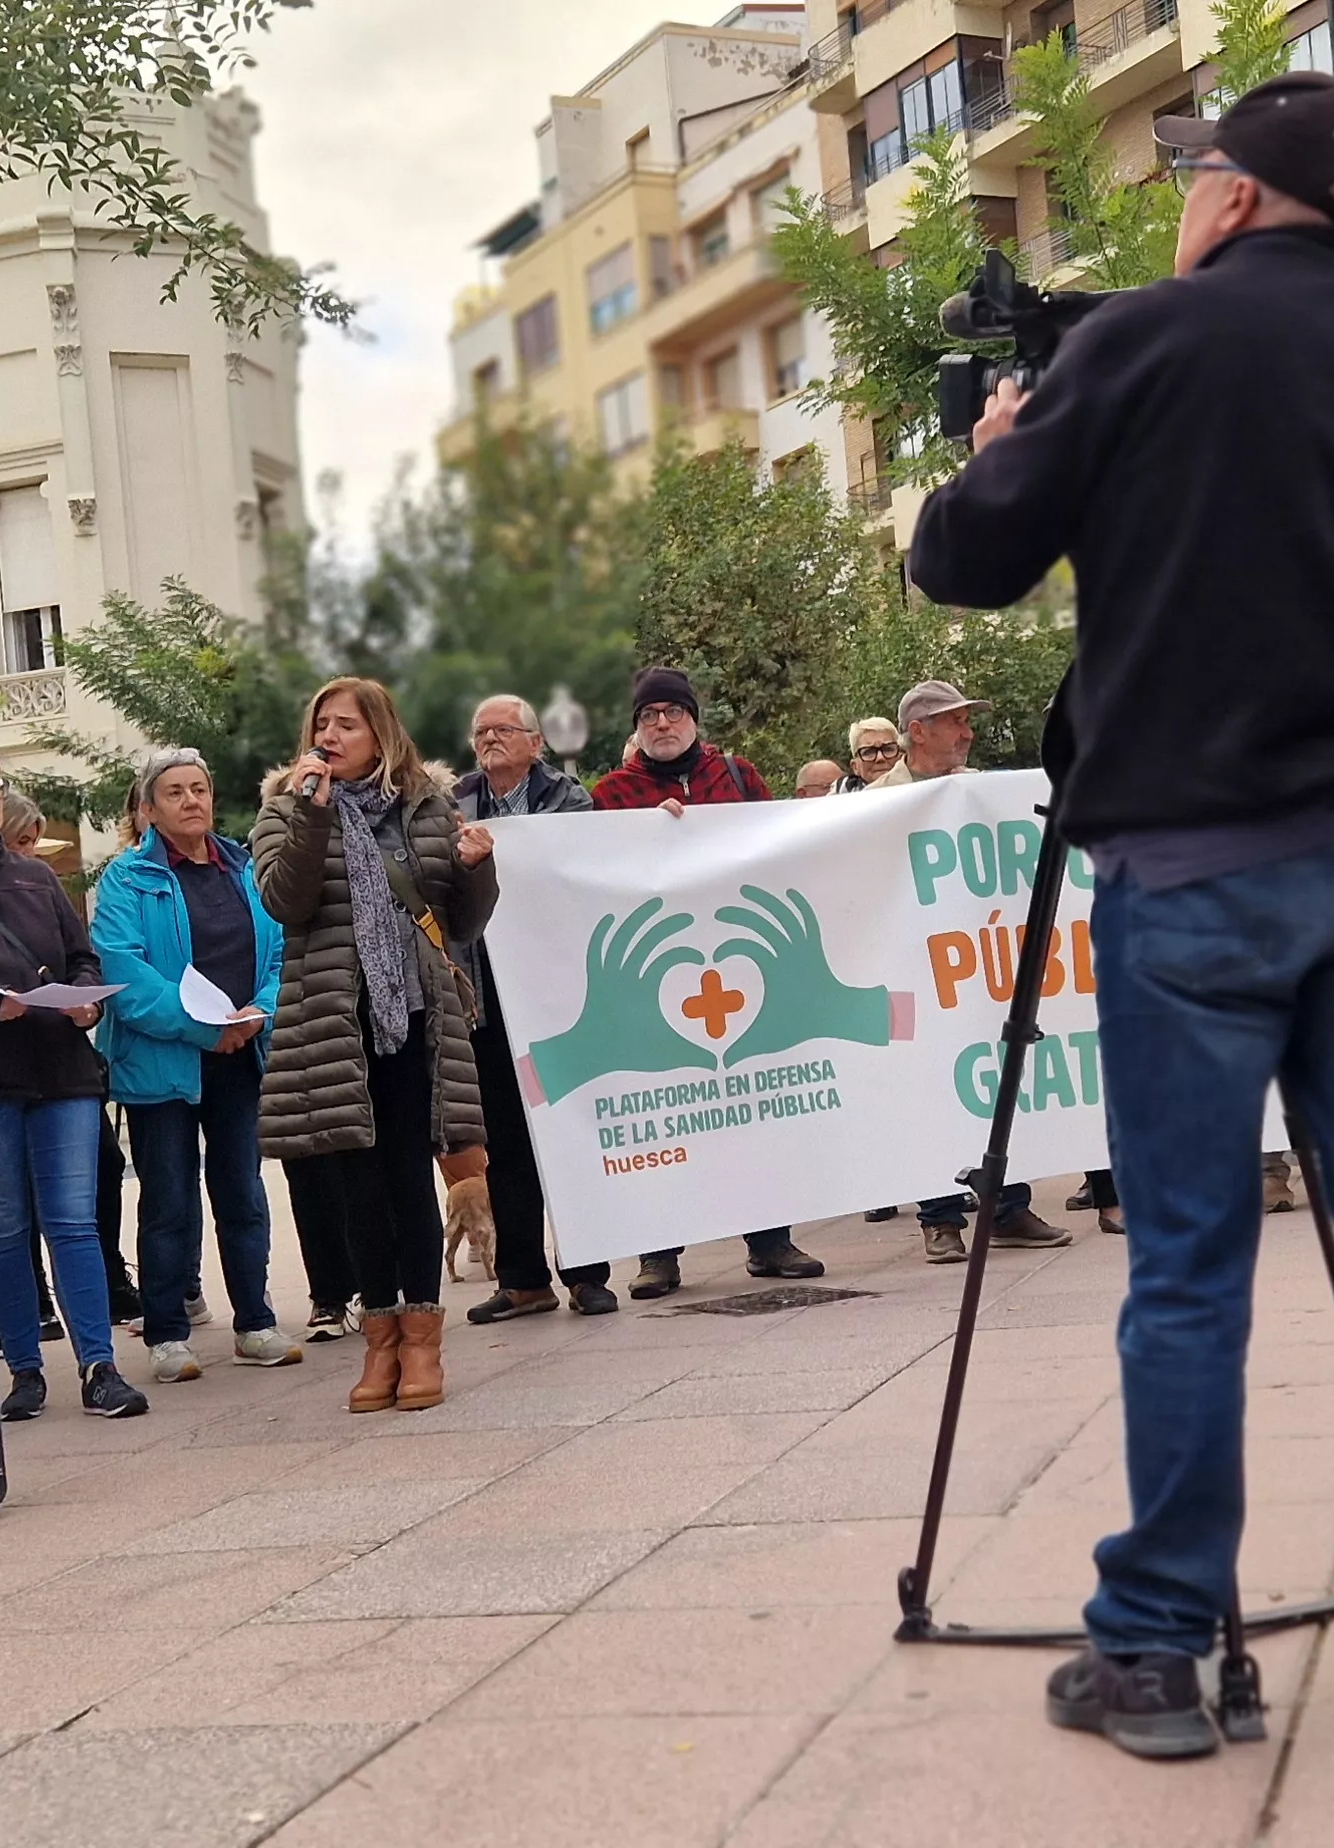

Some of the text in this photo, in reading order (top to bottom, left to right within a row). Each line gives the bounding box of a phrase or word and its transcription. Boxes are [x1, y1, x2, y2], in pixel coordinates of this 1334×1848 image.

[908, 819, 1043, 906] POR
[595, 1059, 837, 1120] PLATAFORMA EN DEFENSA
[598, 1087, 842, 1150] DE LA SANIDAD PÚBLICA
[602, 1146, 688, 1177] huesca
